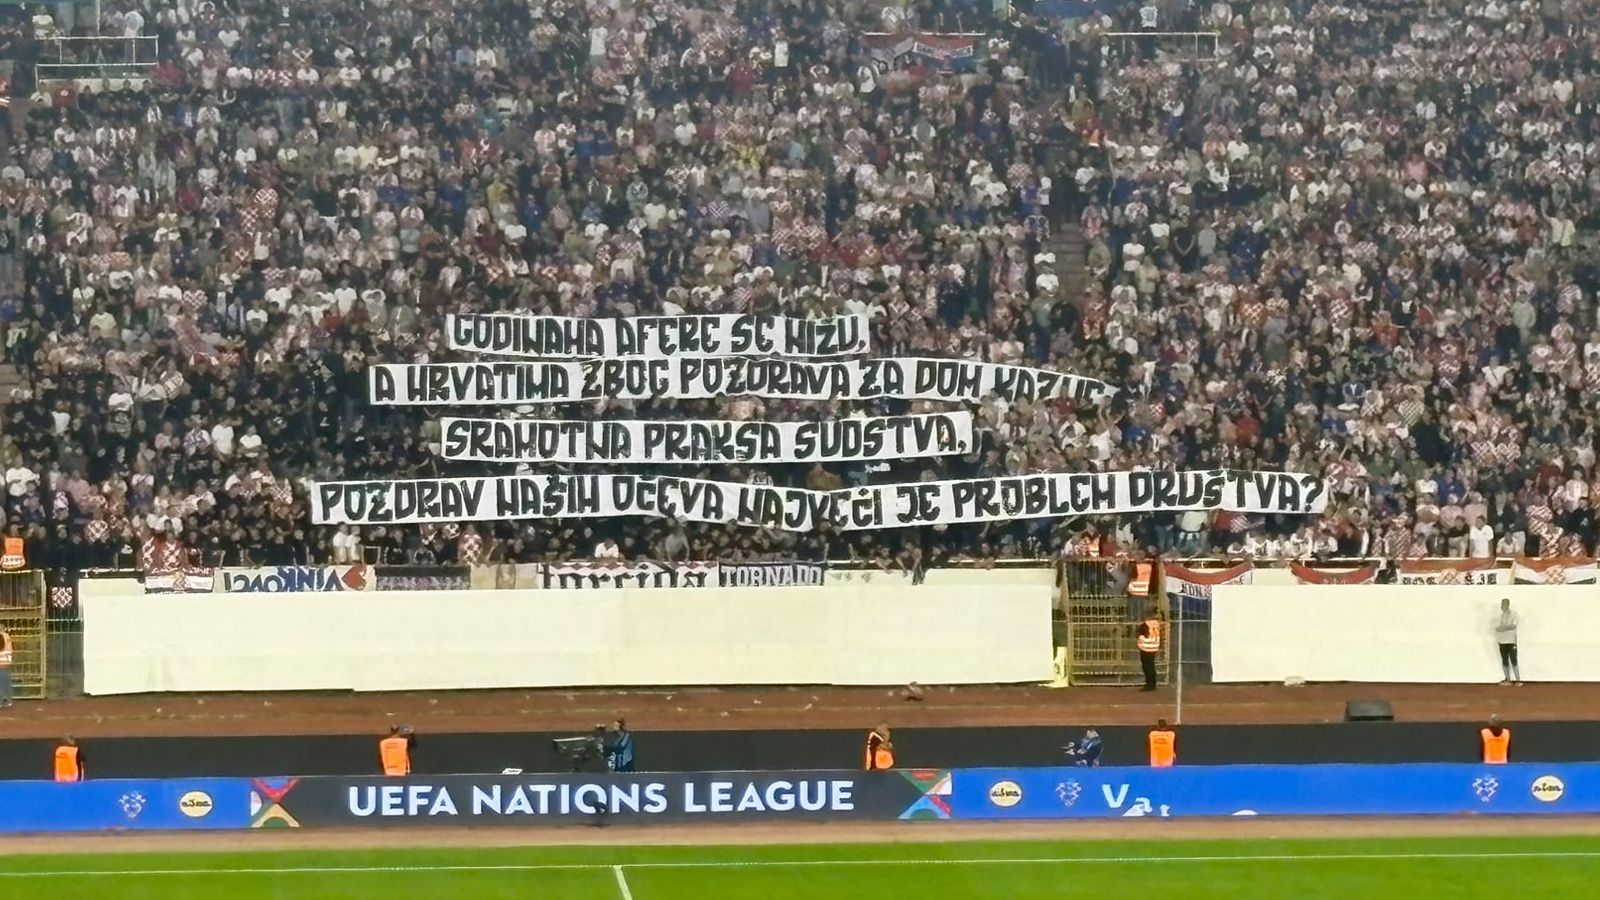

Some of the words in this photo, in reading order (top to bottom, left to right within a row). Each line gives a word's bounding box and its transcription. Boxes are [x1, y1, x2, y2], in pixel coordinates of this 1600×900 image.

[455, 315, 605, 356] GODINAMA
[616, 316, 720, 355] AFERE
[731, 317, 774, 353] SE
[375, 366, 395, 401] A
[407, 364, 569, 401] HRVATIMA
[580, 359, 669, 398] ZBOG
[681, 358, 850, 400] POZDRAVA
[858, 359, 904, 397] ZA
[915, 360, 983, 396] DOM
[446, 420, 631, 460] SRAMOTNA
[644, 421, 781, 462] PRAKSA
[794, 415, 968, 458] SUDSTVA,
[320, 479, 485, 522] POZDRAV
[496, 475, 600, 517] NAŠIH
[612, 475, 724, 520] OČEVA
[896, 485, 941, 522] JE
[952, 474, 1116, 518] PROBLEM
[1129, 469, 1325, 513] DRUŠTVA?
[720, 563, 823, 587] TORNADO
[348, 785, 458, 817] UEFA
[472, 784, 668, 815] NATIONS
[684, 780, 854, 812] LEAGUE
